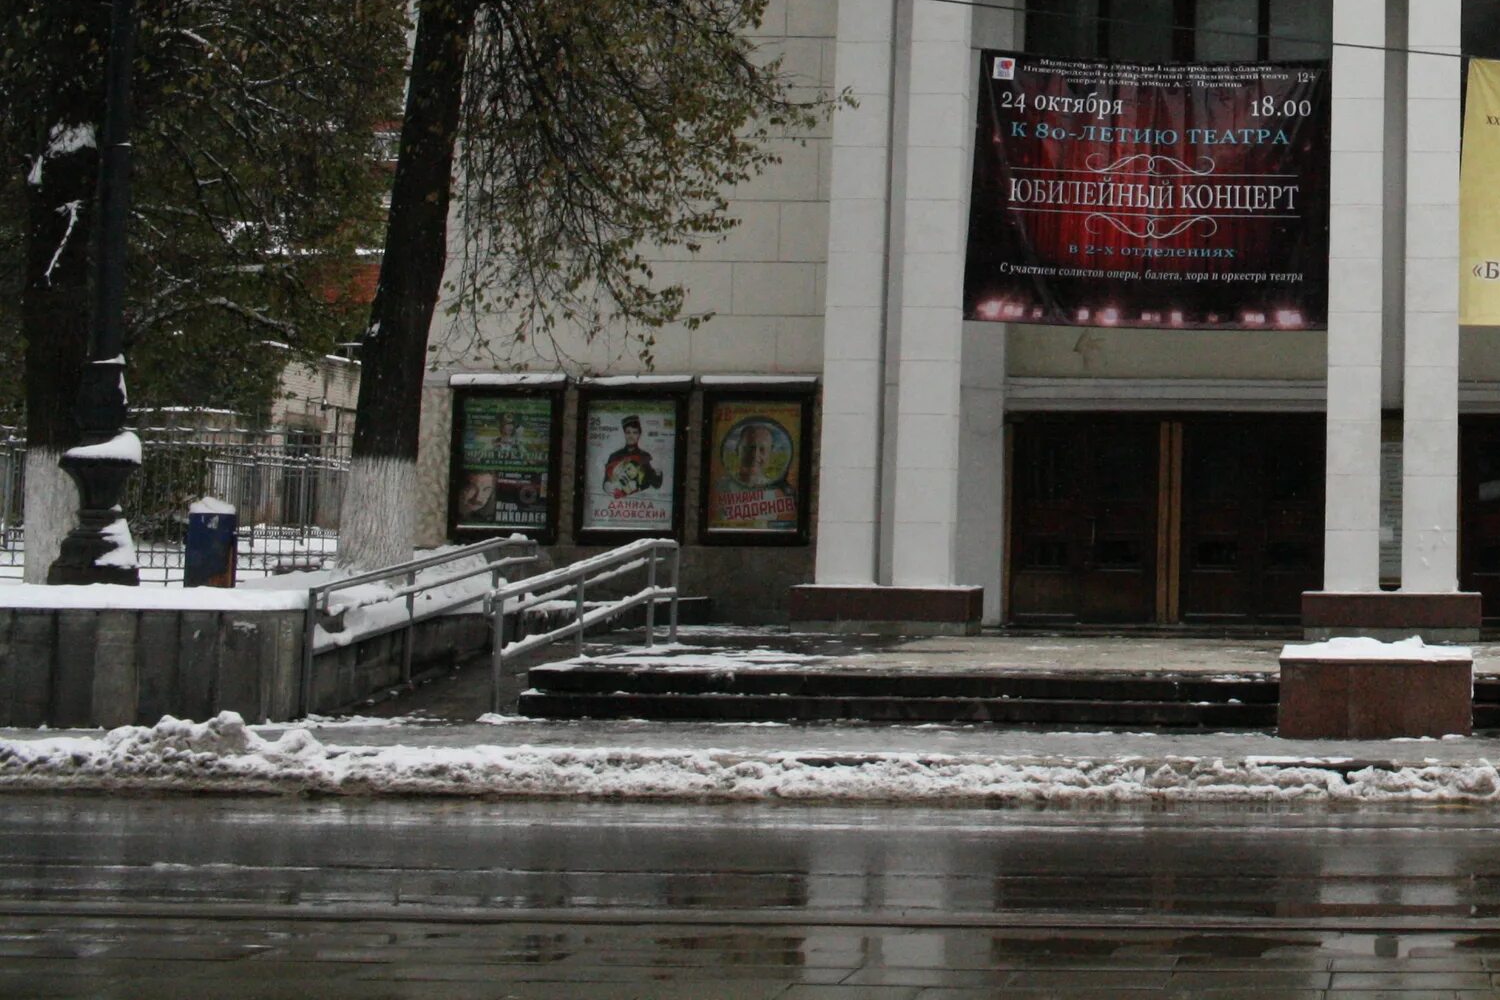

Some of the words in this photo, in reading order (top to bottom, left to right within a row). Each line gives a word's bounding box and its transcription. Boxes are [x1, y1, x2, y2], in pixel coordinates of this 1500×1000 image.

[1297, 71, 1317, 83] 12+
[1001, 91, 1026, 113] 24
[1034, 92, 1124, 120] октября
[1250, 96, 1313, 117] 18.00
[1011, 121, 1027, 138] К
[1034, 123, 1179, 145] 80-ЛЕТИЮ
[1186, 129, 1291, 145] ТЕАТРА
[1008, 175, 1174, 209] ЮБИЛЕЙНЫЙ
[1180, 184, 1299, 213] КОНЦЕРТ
[1120, 246, 1235, 259] отделениях
[1000, 262, 1009, 273] С
[1009, 264, 1056, 277] участием
[1058, 266, 1104, 278] солистов
[1107, 269, 1142, 283] оперы,
[1144, 269, 1183, 282] балета,
[1184, 271, 1209, 283] хора
[1221, 271, 1267, 284] оркестра
[1269, 271, 1304, 283] театра
